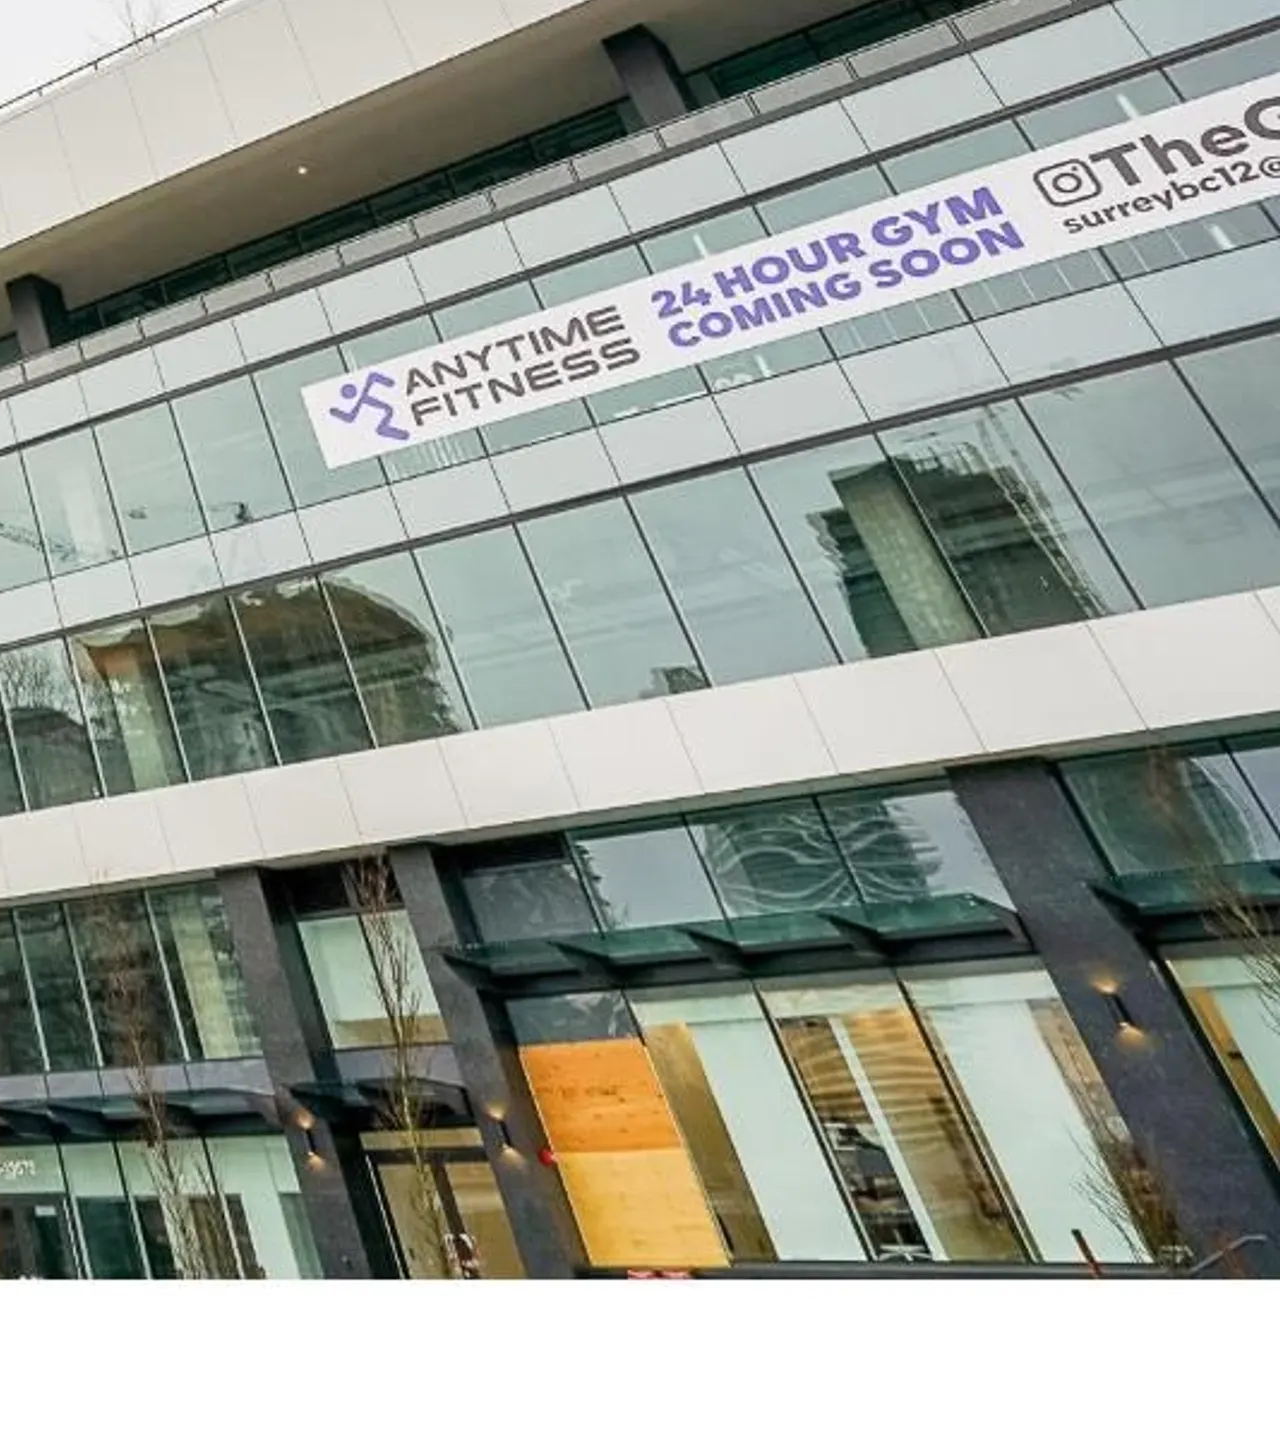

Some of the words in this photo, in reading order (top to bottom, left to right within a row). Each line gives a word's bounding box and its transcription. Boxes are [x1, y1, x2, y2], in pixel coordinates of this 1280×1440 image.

[651, 285, 713, 319] 24
[714, 232, 867, 301] HOUR
[871, 186, 1004, 246] GYM
[667, 272, 862, 347] COMING
[868, 222, 1025, 288] SOON
[405, 305, 627, 396] ANYTIME
[409, 338, 641, 427] FITNESS
